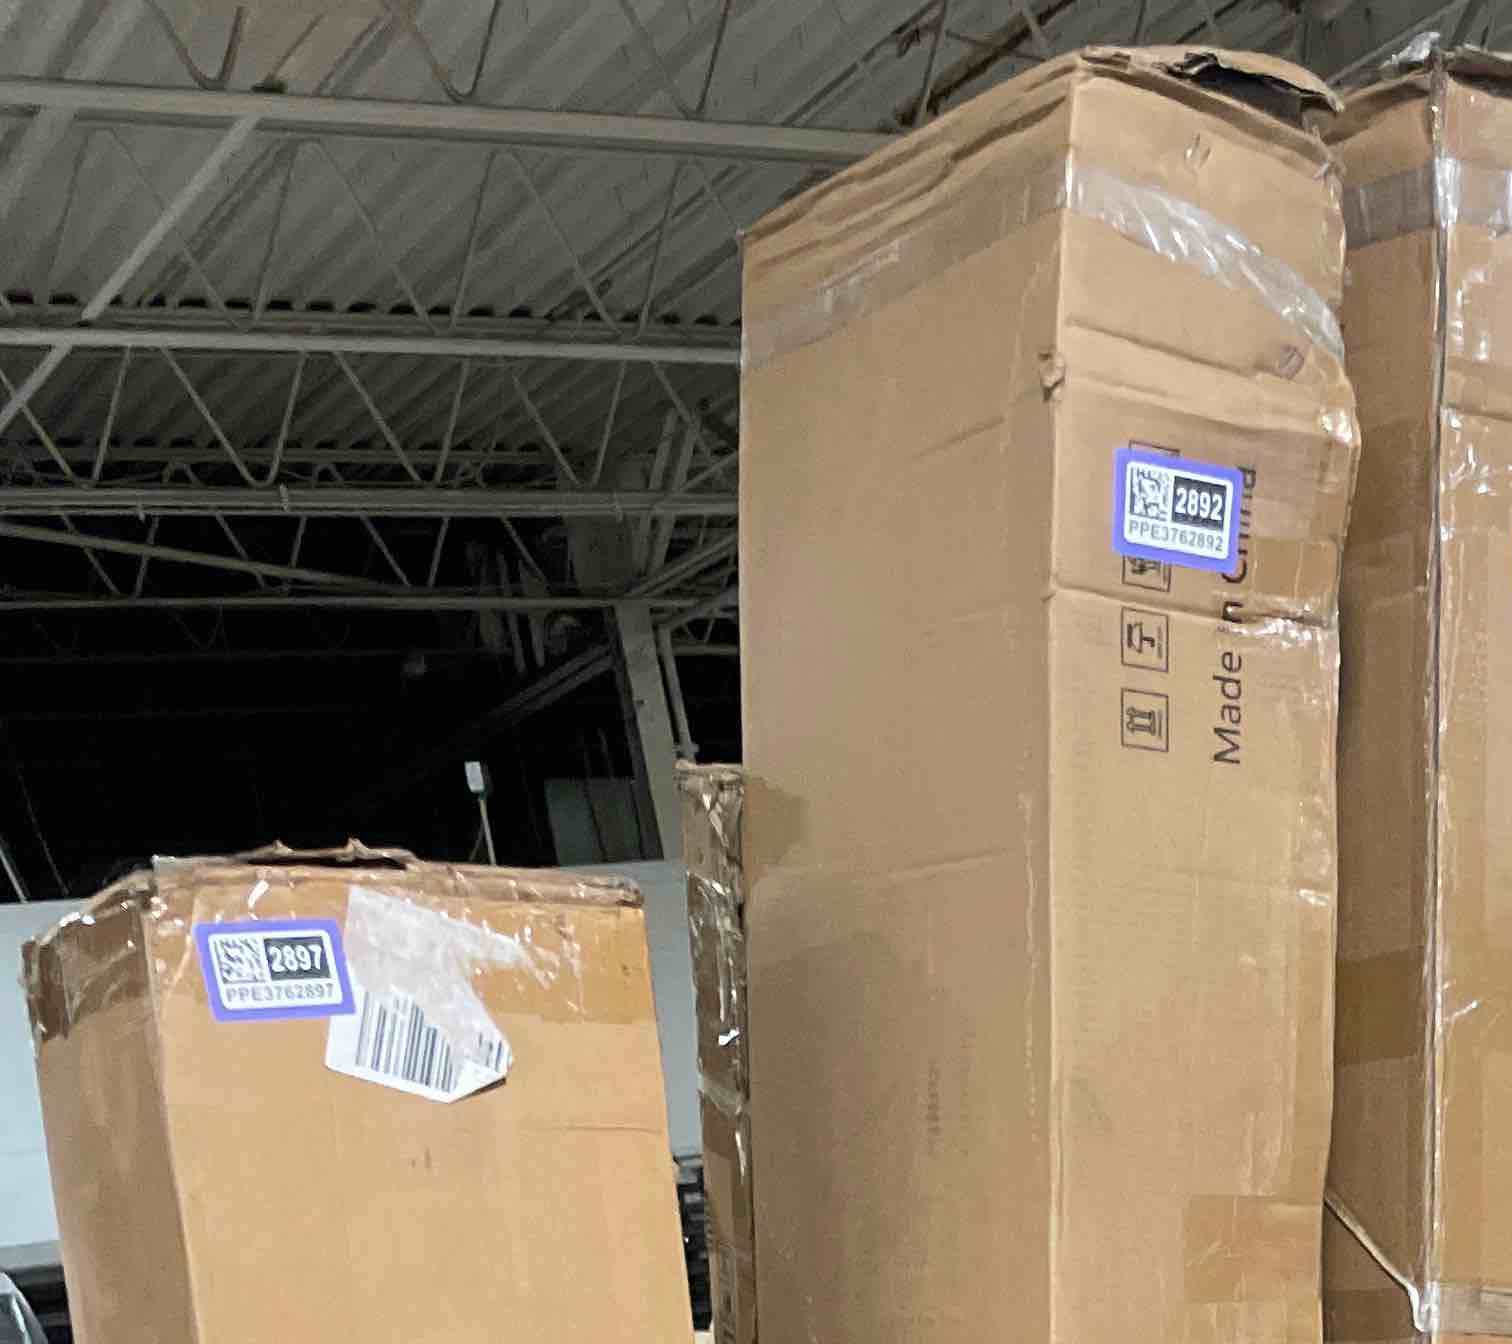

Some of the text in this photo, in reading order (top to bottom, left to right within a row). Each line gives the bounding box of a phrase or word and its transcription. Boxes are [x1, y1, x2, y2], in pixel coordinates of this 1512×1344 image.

[1173, 486, 1227, 521] 2892
[1128, 519, 1224, 552] PPE3762892
[1213, 651, 1242, 764] Made
[269, 943, 323, 973] 2897
[226, 982, 335, 1003] PPE3762897
